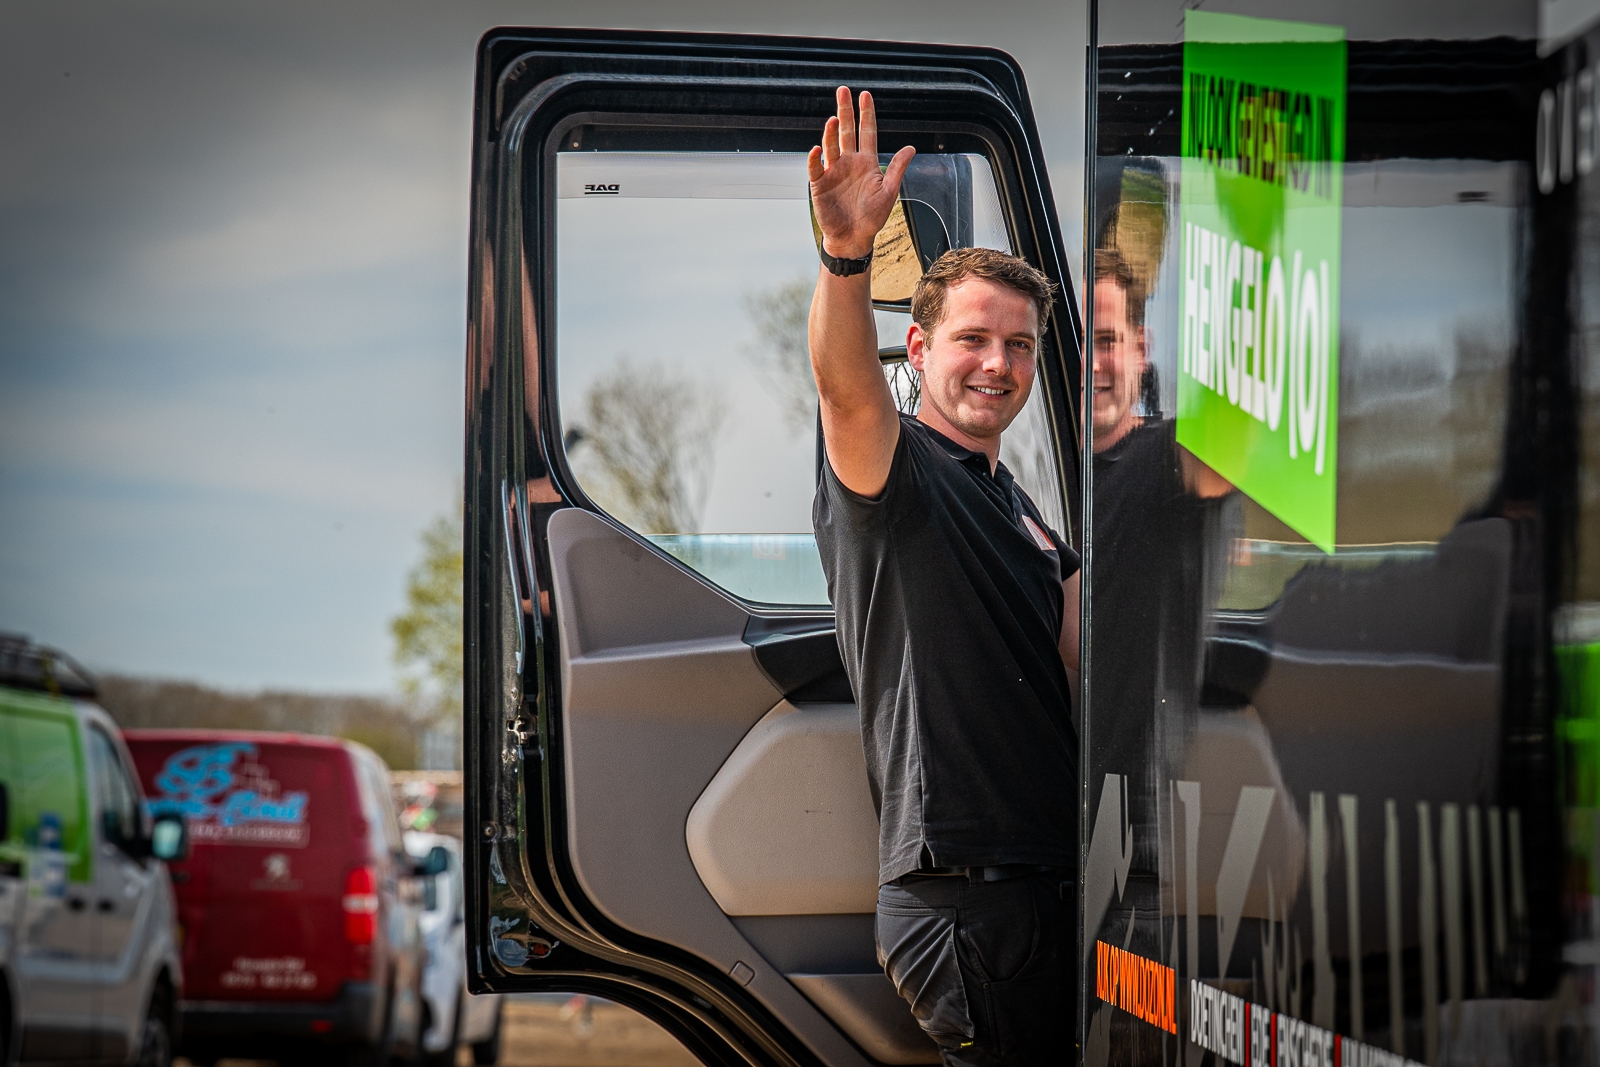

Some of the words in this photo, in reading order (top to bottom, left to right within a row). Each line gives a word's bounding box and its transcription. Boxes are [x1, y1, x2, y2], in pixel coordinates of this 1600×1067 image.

[1189, 72, 1206, 161] NU
[1208, 75, 1235, 172] OOK
[1236, 80, 1312, 193] GEVESTIGD
[1316, 96, 1336, 199] IN
[1184, 221, 1285, 431] HENGELO
[1288, 250, 1330, 476] (O)
[1109, 944, 1120, 1007] OP
[1119, 948, 1178, 1036] WWW.DOZON.NL
[1190, 978, 1245, 1067] DOETINCHEM
[1250, 1002, 1271, 1067] EDE
[1276, 1012, 1334, 1067] ENSCHEDE
